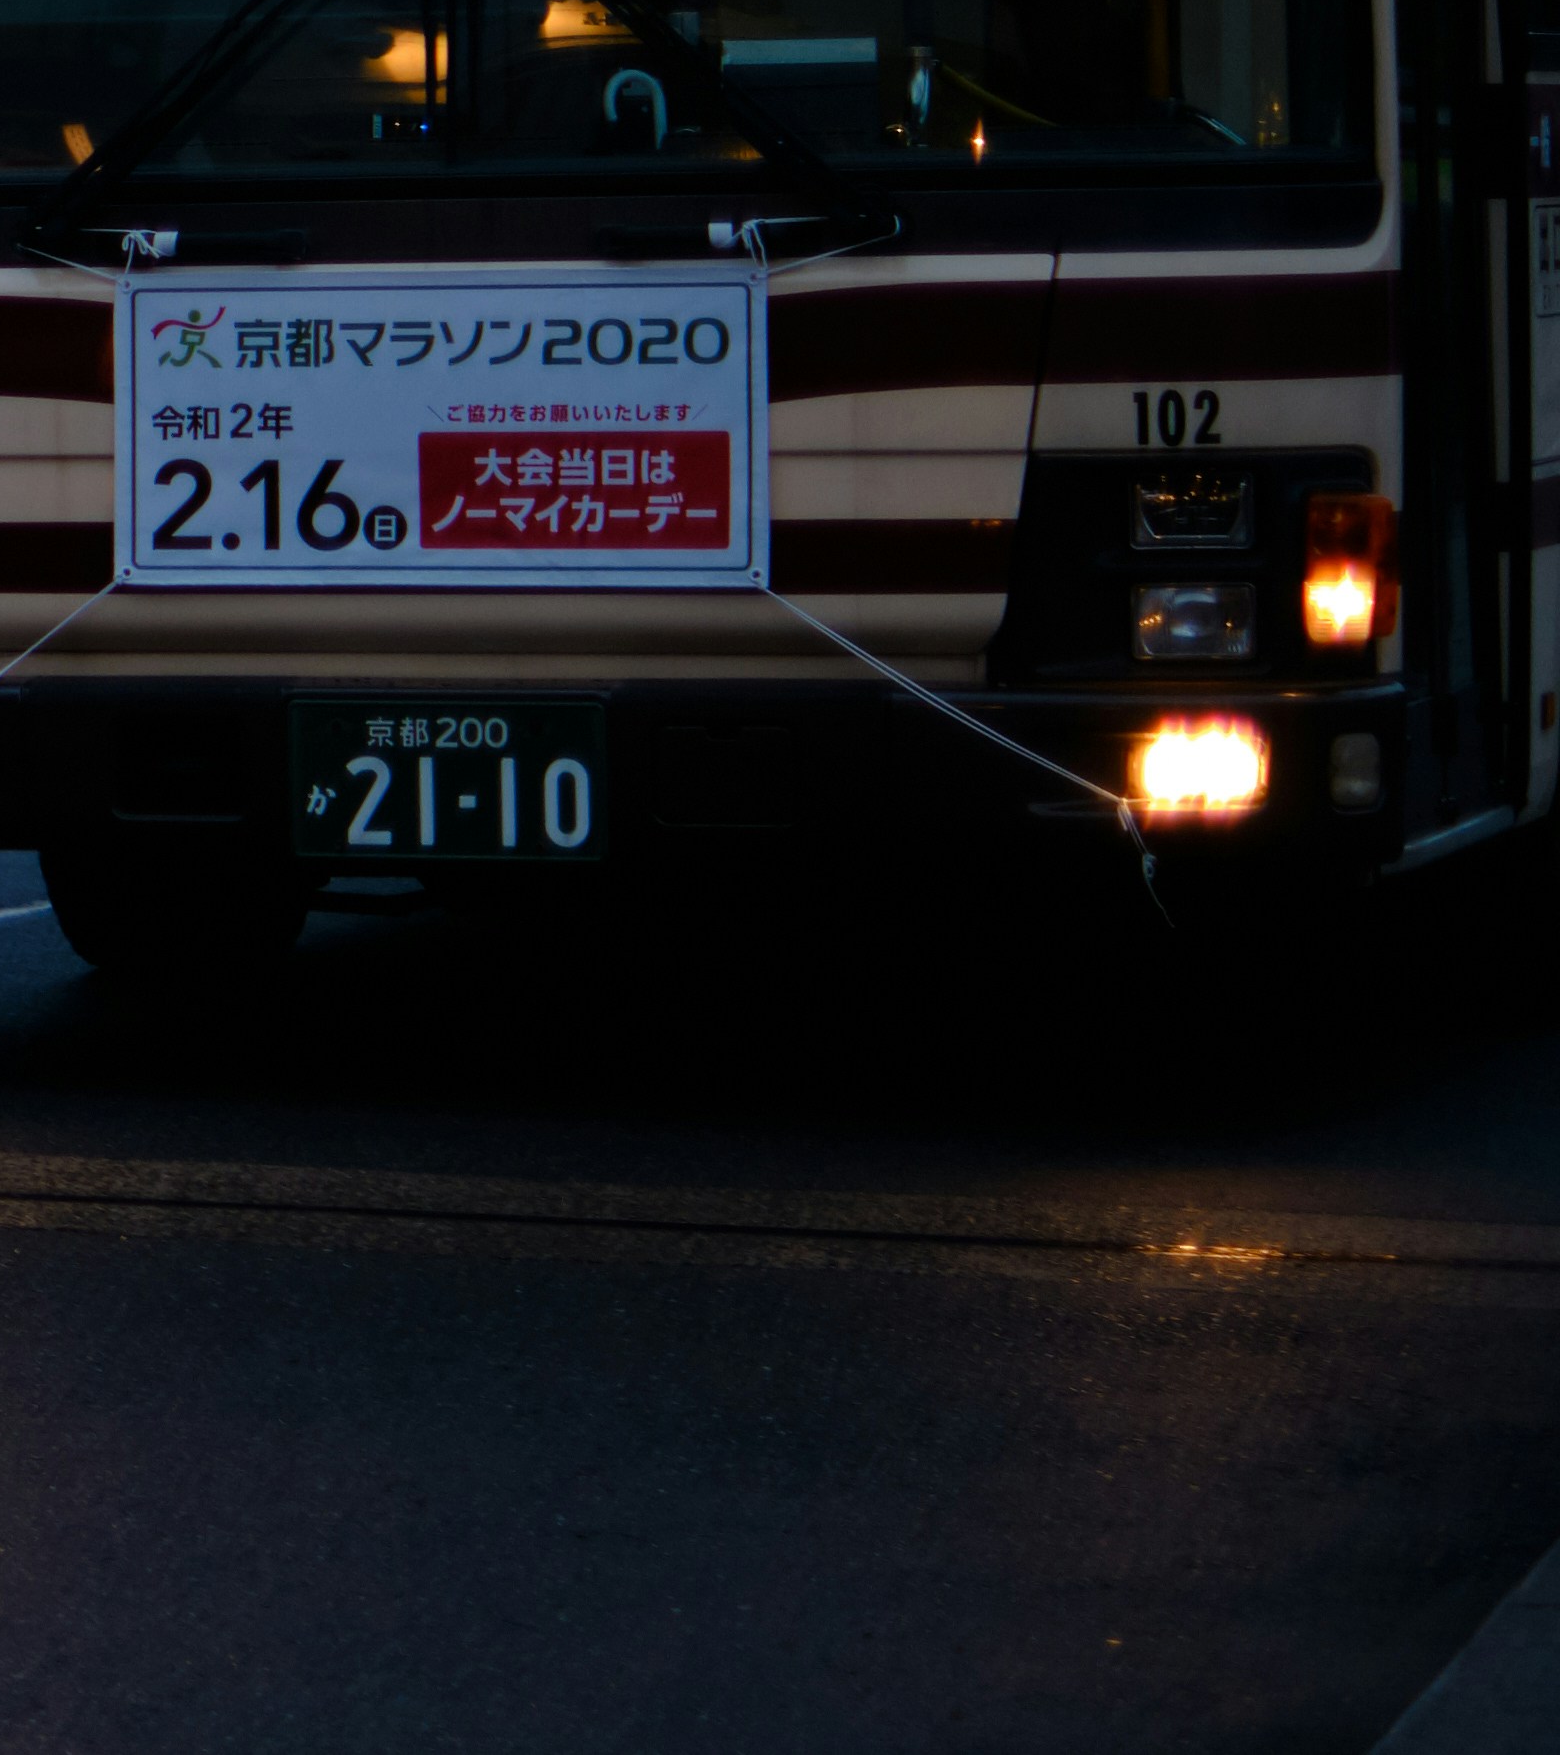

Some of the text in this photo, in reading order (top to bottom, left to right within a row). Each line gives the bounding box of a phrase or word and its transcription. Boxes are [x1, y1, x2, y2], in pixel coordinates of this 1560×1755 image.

[234, 317, 731, 369] 京都マラソン2020
[152, 403, 294, 441] 令和2年
[445, 402, 693, 424] ご協力をお願いいたします
[1133, 389, 1221, 447] 102
[474, 448, 676, 488] 大会当日は
[431, 493, 718, 535] ノーマイカーデー
[305, 755, 592, 848] か 21-10
